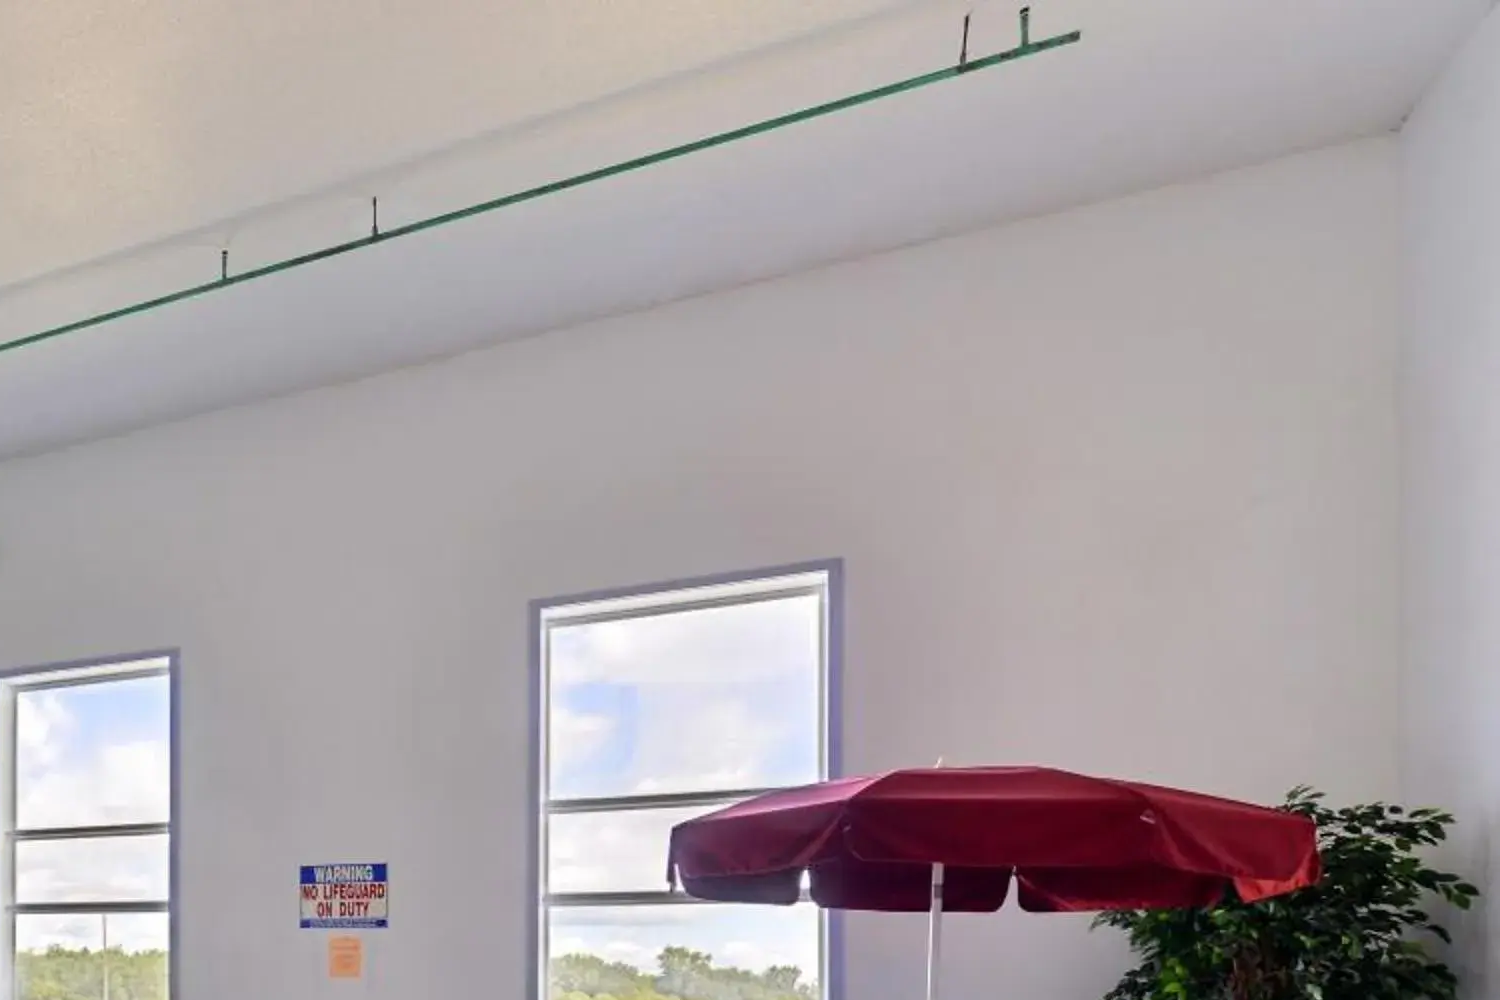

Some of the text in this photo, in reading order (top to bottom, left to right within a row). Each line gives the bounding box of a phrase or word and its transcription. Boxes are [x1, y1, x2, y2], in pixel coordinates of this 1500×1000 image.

[314, 865, 373, 882] WARNING
[303, 884, 384, 900] NO LIFEGUARD
[317, 902, 370, 917] ON DUTY
